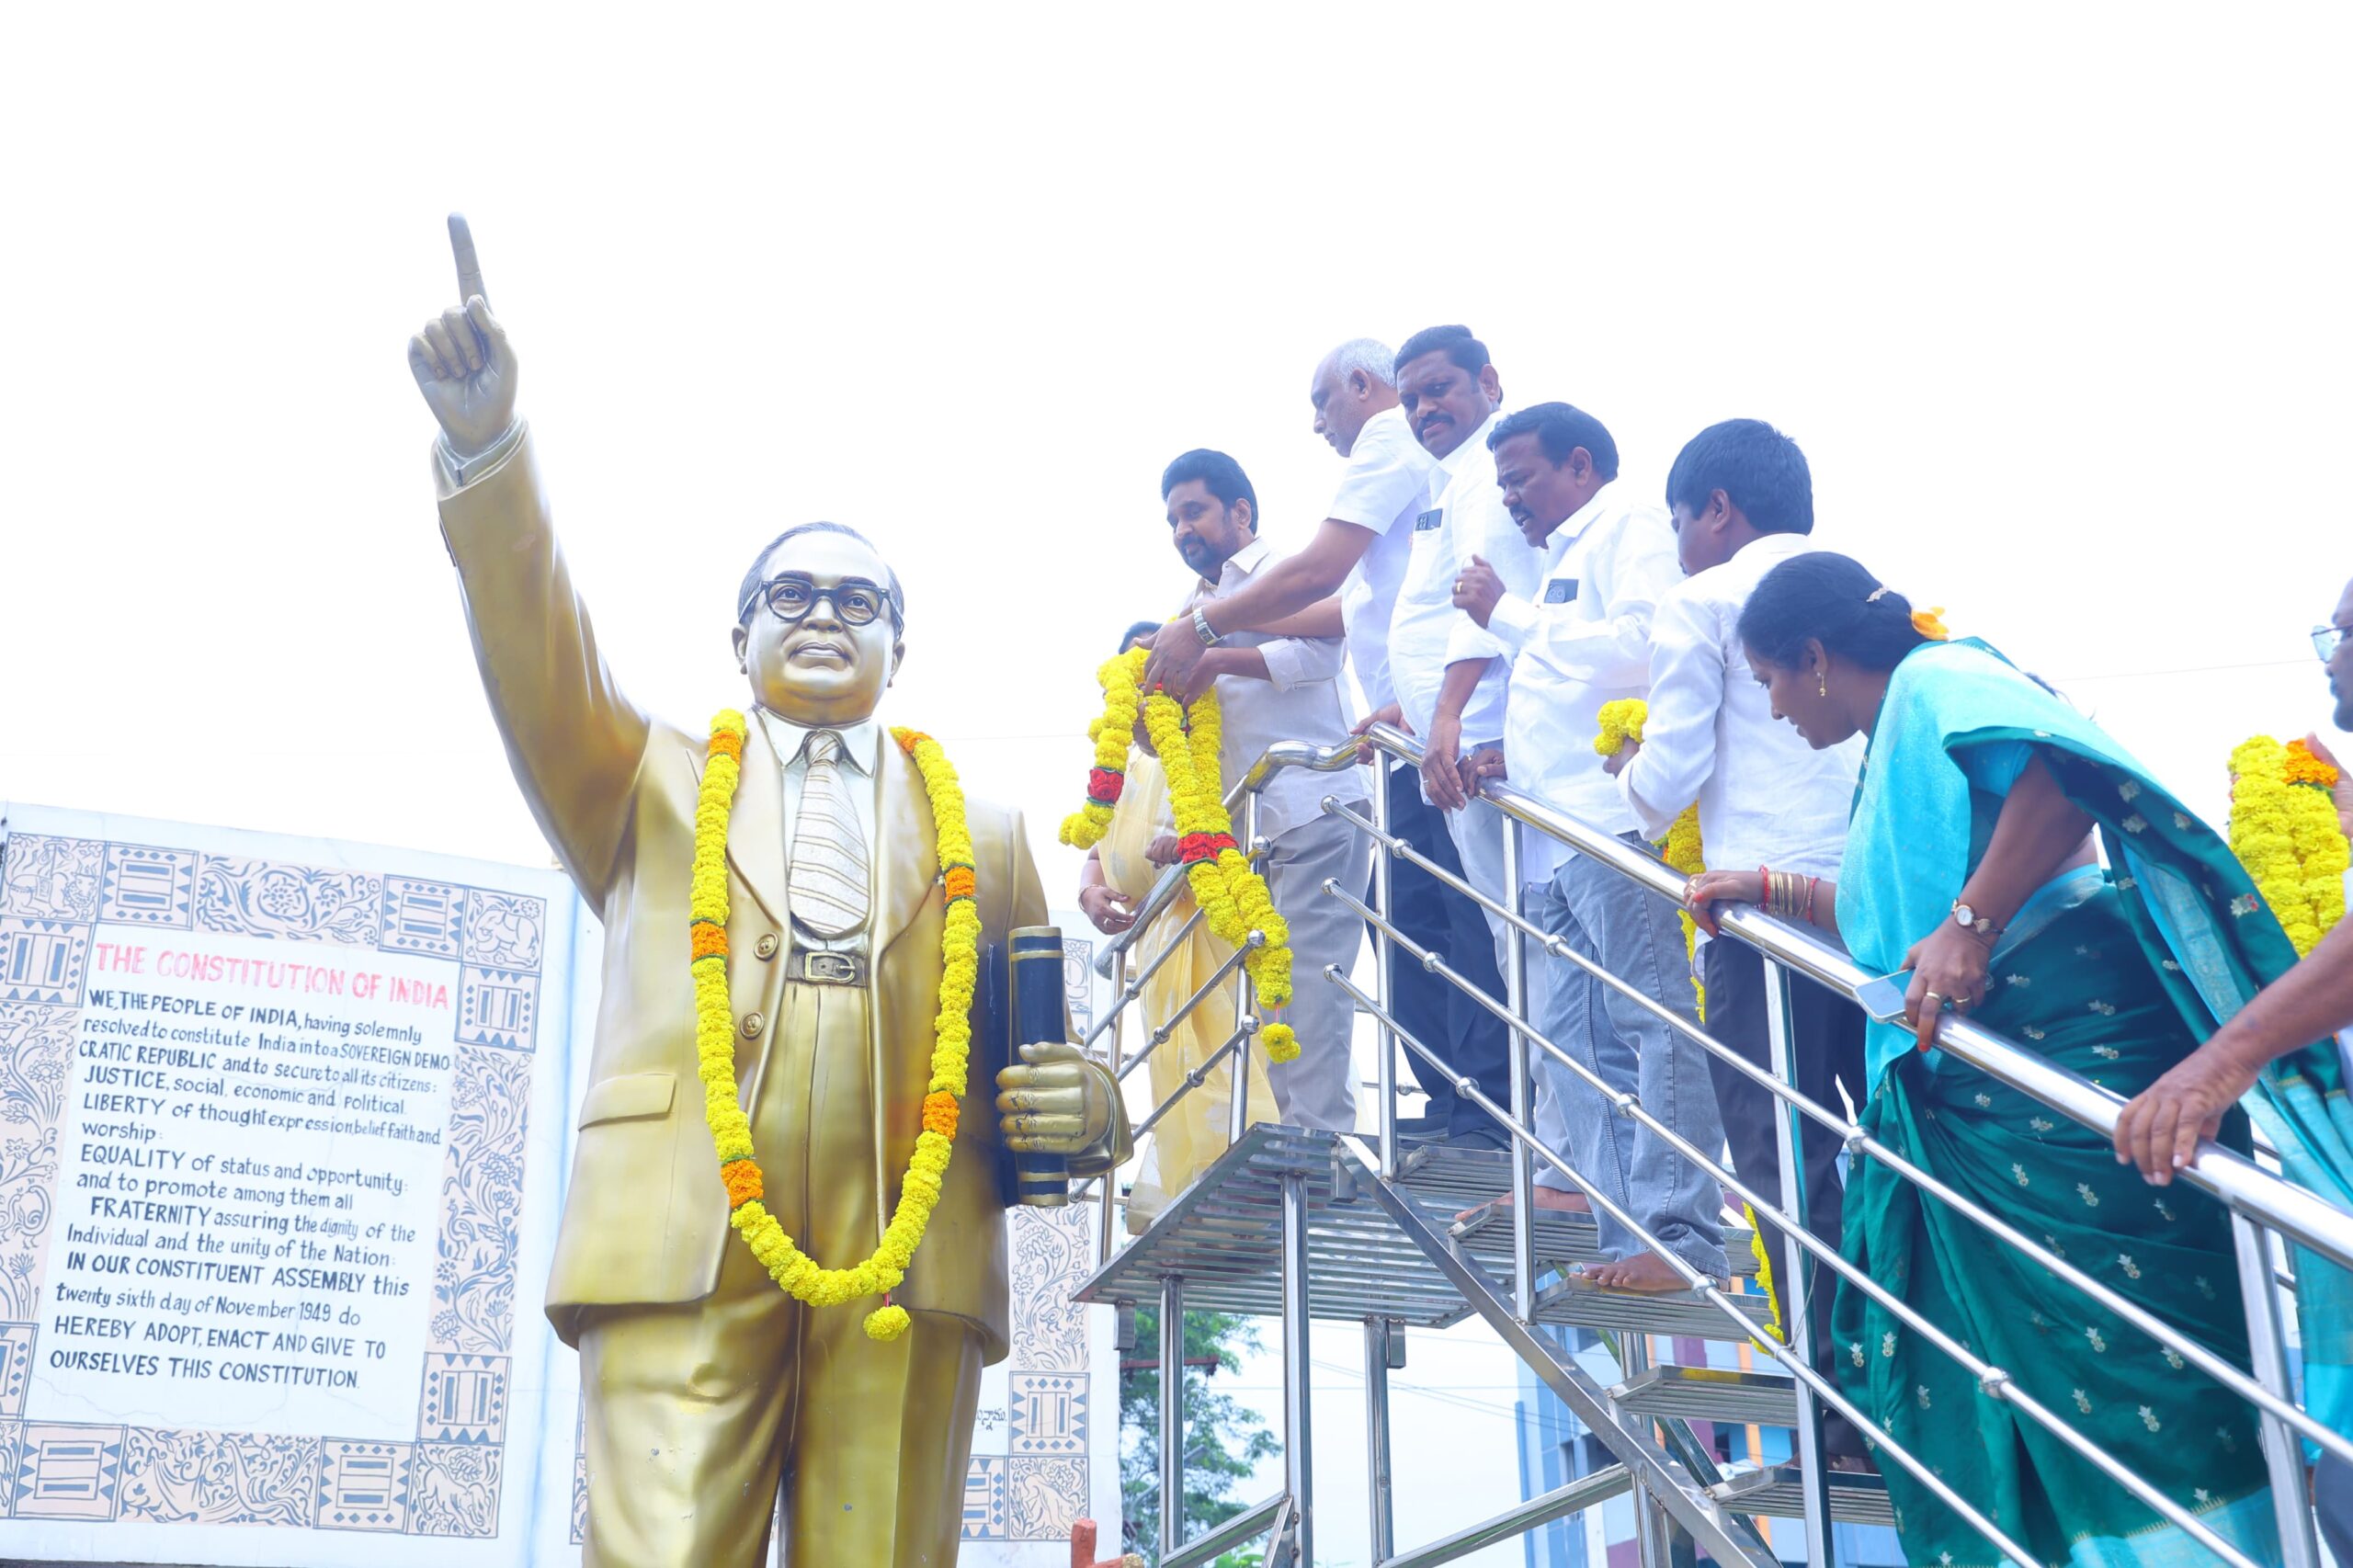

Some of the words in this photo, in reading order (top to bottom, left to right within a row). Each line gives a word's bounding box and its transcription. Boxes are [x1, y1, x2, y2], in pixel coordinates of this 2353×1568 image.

[96, 943, 147, 973] THE
[157, 950, 345, 995] CONSTITUTION
[352, 972, 382, 999] OF
[390, 976, 449, 1009] INDIA
[119, 991, 149, 1010] THE
[151, 994, 217, 1017] PEOPLE
[221, 1005, 244, 1021] OF
[249, 1007, 301, 1031] INDIA,
[303, 1012, 351, 1038] having
[354, 1020, 422, 1046] solemnly
[83, 1017, 151, 1037] resolved
[152, 1021, 168, 1040] to
[171, 1027, 251, 1047] constitute
[258, 1032, 296, 1053] India
[339, 1043, 412, 1066] SOVEREIGN
[79, 1040, 132, 1062] CRATIC
[136, 1045, 217, 1070] REPUBLIC
[222, 1056, 251, 1073] and
[253, 1057, 268, 1074] to
[274, 1063, 323, 1081] secure
[324, 1064, 340, 1082] to
[341, 1067, 358, 1087] all
[361, 1069, 377, 1086] its
[379, 1071, 437, 1093] citizens:
[84, 1064, 170, 1092] JUSTICE,
[233, 1084, 305, 1103] economic
[307, 1086, 336, 1107] and
[83, 1092, 166, 1115] LIBERTY
[172, 1103, 194, 1119] of
[198, 1103, 267, 1128] thought
[388, 1122, 415, 1141] faith
[416, 1128, 441, 1145] and
[81, 1143, 186, 1170] EQUALITY
[191, 1154, 216, 1173] of
[220, 1157, 270, 1176] status
[274, 1162, 302, 1180] and
[76, 1170, 113, 1189] and
[117, 1172, 139, 1191] to
[144, 1179, 228, 1199] promote
[233, 1187, 285, 1208] among
[290, 1187, 330, 1208] them
[335, 1194, 353, 1210] all
[67, 1222, 150, 1248] Individual
[154, 1231, 189, 1252] and
[197, 1233, 224, 1253] the
[231, 1237, 270, 1260] unity
[275, 1239, 296, 1258] of
[300, 1239, 327, 1261] the
[90, 1196, 213, 1227] FRATERNITY
[213, 1210, 290, 1235] assuring
[294, 1214, 317, 1233] the
[320, 1217, 358, 1242] dignity
[365, 1222, 386, 1239] of
[391, 1224, 415, 1243] the
[67, 1251, 86, 1271] IN
[91, 1255, 131, 1275] OUR
[135, 1257, 266, 1285] CONSTITUENT
[271, 1267, 366, 1293] ASSEMBLY
[373, 1275, 410, 1296] this
[56, 1282, 111, 1308] twenty
[116, 1288, 155, 1309] sixth
[159, 1291, 191, 1316] day
[195, 1295, 214, 1313] of
[215, 1296, 296, 1319] November
[299, 1301, 331, 1323] 1949
[338, 1305, 360, 1325] do
[54, 1314, 137, 1340] HEREBY
[143, 1322, 203, 1348] ADOPT,
[207, 1328, 271, 1350] ENACT
[272, 1332, 307, 1352] AND
[311, 1336, 356, 1357] GIVE
[365, 1340, 386, 1359] TO
[50, 1349, 160, 1376] OURSELVES
[167, 1357, 212, 1379] THIS
